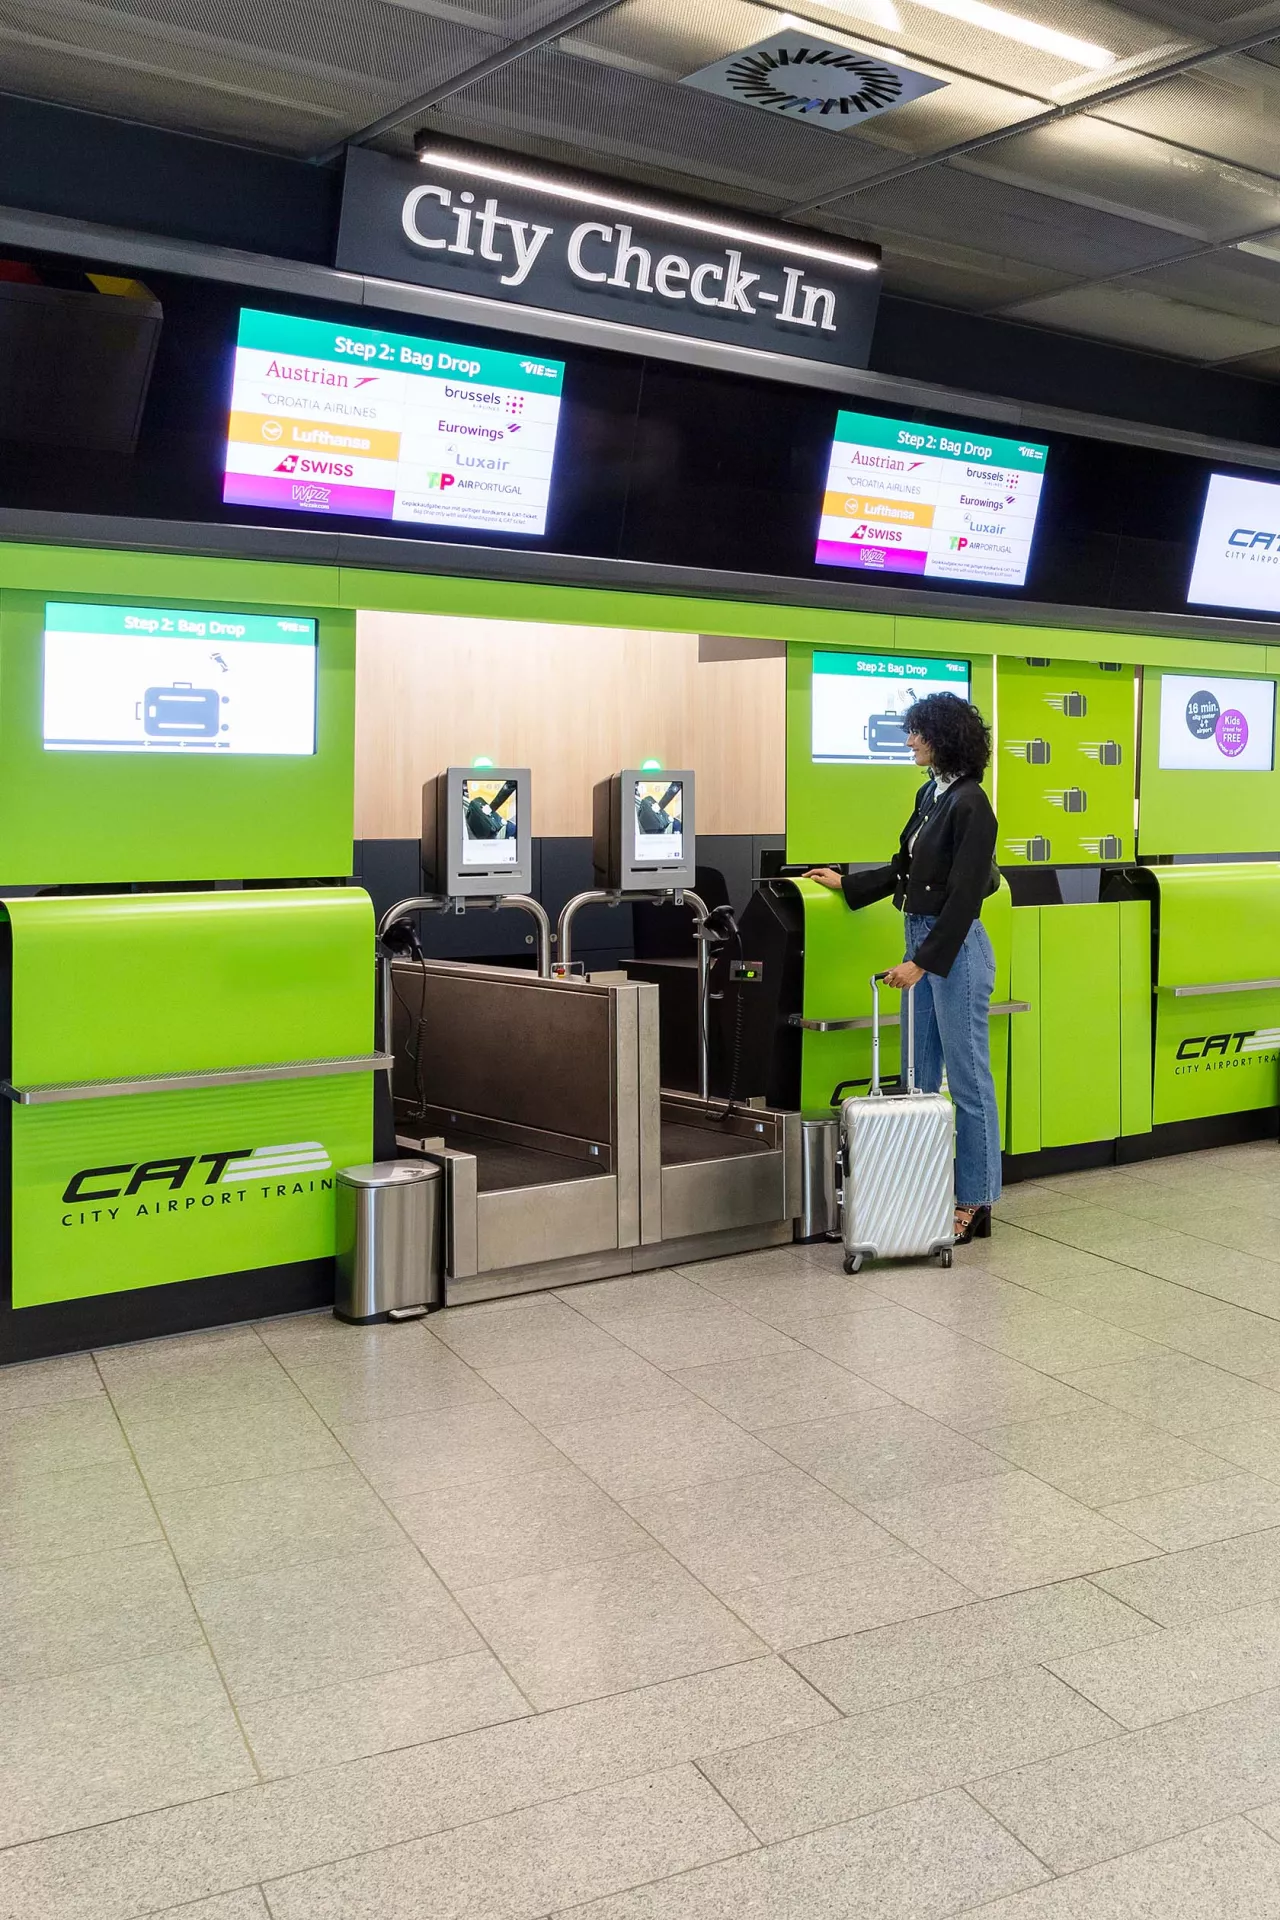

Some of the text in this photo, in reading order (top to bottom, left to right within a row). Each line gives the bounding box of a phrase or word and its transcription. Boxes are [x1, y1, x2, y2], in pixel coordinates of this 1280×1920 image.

[401, 184, 837, 331] City Check-In
[334, 336, 481, 377] Step 2: Bag Drop
[265, 360, 348, 387] Austrian
[445, 385, 501, 405] brussels
[267, 393, 377, 419] CROATIA AIRLINES
[292, 426, 371, 450] Lufthansa
[438, 419, 504, 441] Eurowings
[897, 430, 992, 460] Step 2: Bag Drop
[300, 459, 354, 477] SWISS
[456, 454, 510, 471] Luxair
[851, 450, 905, 471] Austrian
[966, 467, 1004, 482] brussels
[850, 477, 921, 495] CROATIA AIRLINES
[864, 502, 915, 520] Lufthansa
[960, 494, 1004, 511] Eurowings
[867, 528, 902, 542] SWISS
[969, 522, 1006, 535] Luxair
[1228, 528, 1280, 551] CA
[1225, 550, 1279, 565] CITY AIRPO
[124, 615, 246, 638] Step 2: Bag Drop
[856, 661, 928, 677] Step 2: Bag Drop
[1188, 700, 1219, 714] 16 min.
[1224, 715, 1241, 725] Kids
[1222, 733, 1241, 743] FREE
[1176, 1030, 1256, 1060] CAT
[1174, 1064, 1200, 1075] CITY
[1205, 1057, 1252, 1071] AIRPORT
[62, 1148, 253, 1203] CAT
[61, 1178, 333, 1227] CITY AIRPORT TRAIN
